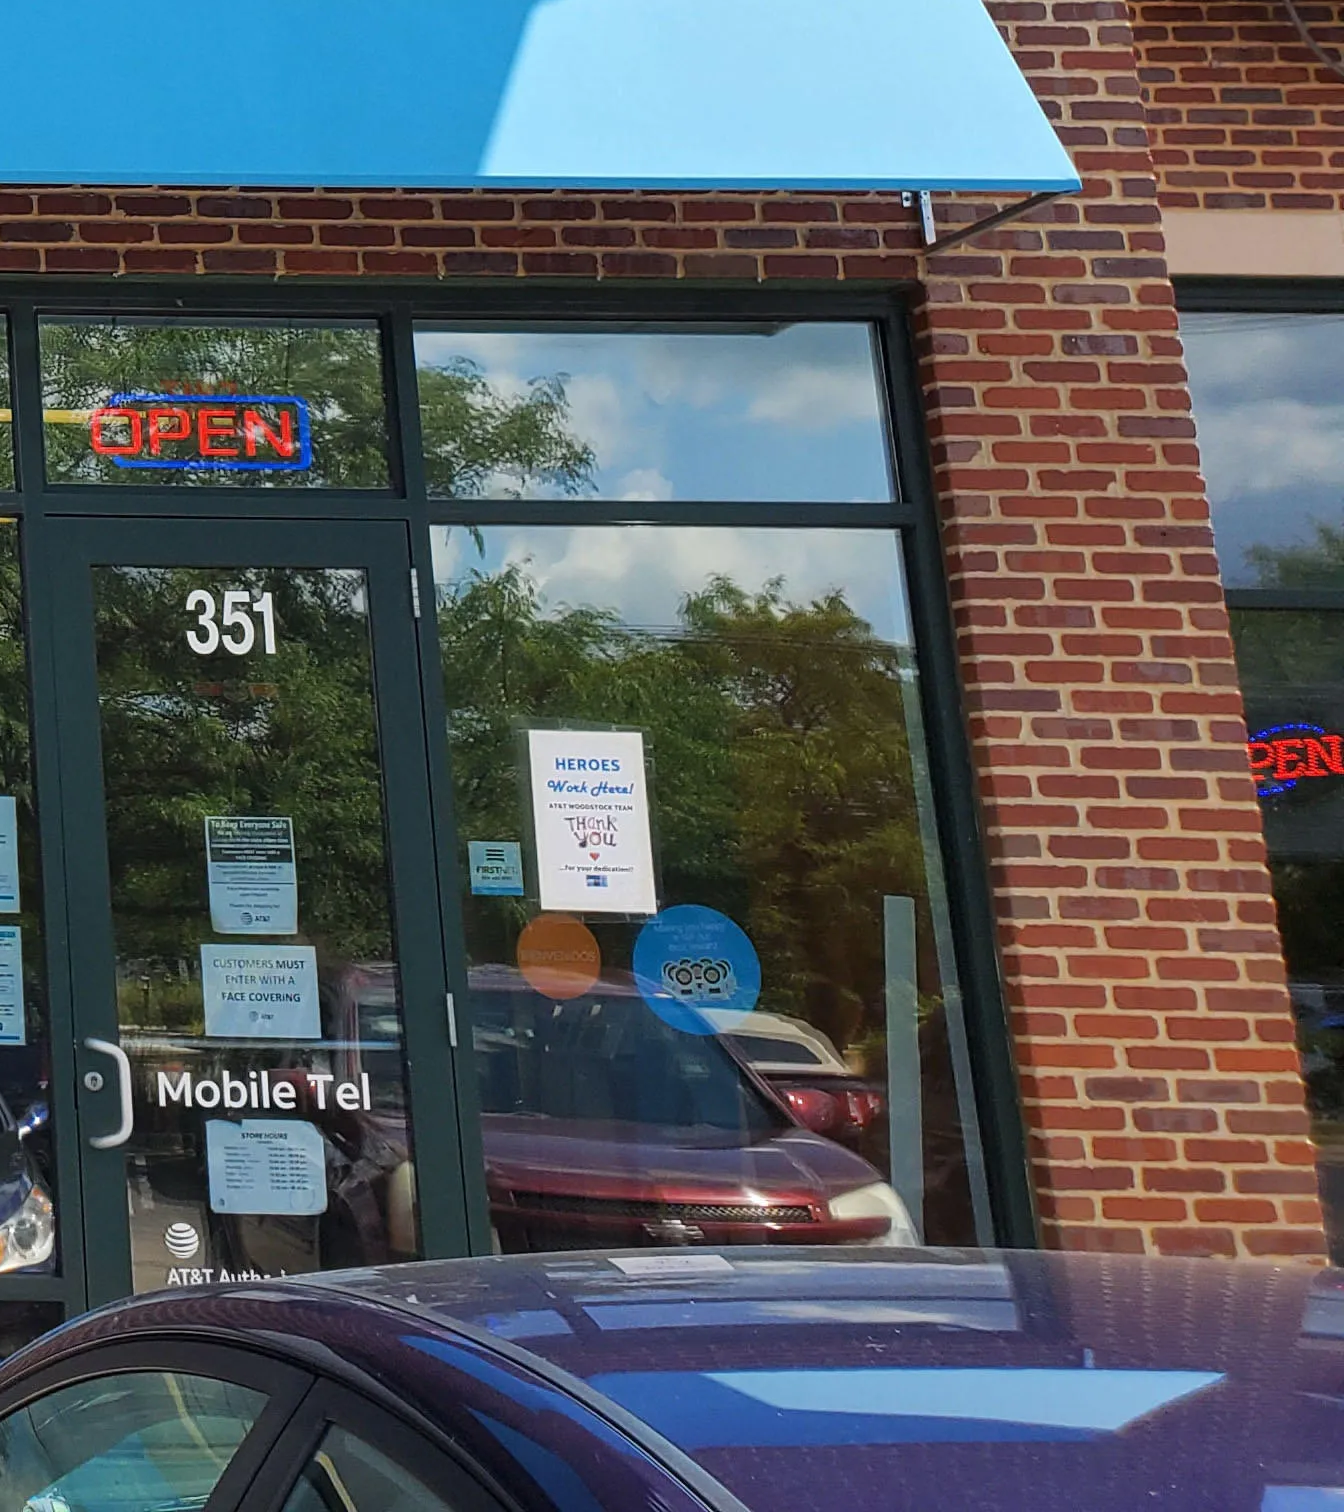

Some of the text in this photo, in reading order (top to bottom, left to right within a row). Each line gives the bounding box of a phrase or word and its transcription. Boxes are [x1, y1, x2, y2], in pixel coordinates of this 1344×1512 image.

[90, 407, 295, 457] OPEN
[185, 589, 277, 655] 351
[555, 757, 621, 772] HEROES
[1248, 734, 1344, 781] PEN
[547, 779, 635, 797] Work Here!
[568, 803, 613, 811] WOODSTOCK
[213, 958, 305, 969] CUSTOMERS MUST
[225, 974, 295, 985] ENTER WITH A
[221, 991, 301, 1003] FACE COVERING
[157, 1070, 371, 1110] Mobile Tel
[240, 1132, 288, 1140] STORE HOURS
[168, 1267, 214, 1286] AT&T
